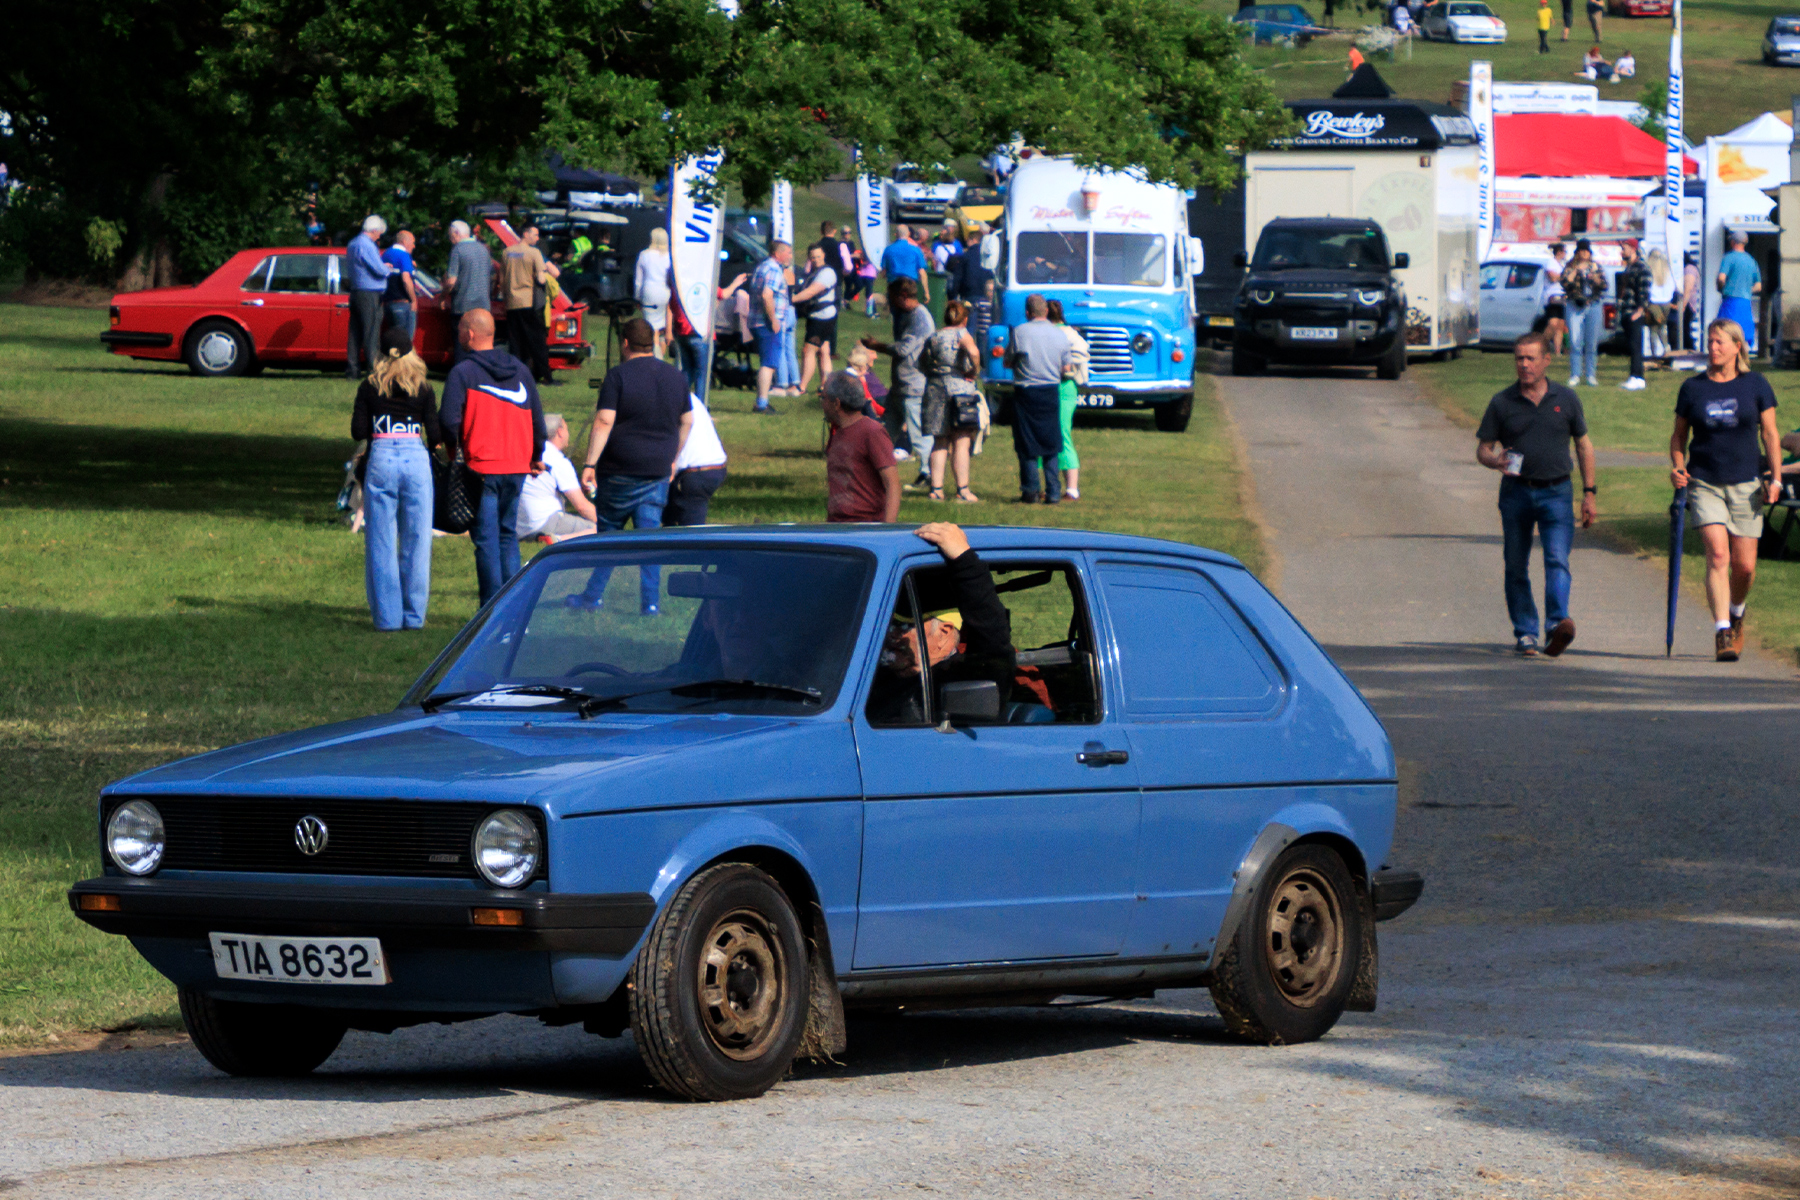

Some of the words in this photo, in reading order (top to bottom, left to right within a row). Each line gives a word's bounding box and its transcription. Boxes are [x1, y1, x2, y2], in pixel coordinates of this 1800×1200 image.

[1302, 110, 1385, 137] Bewley's
[1668, 69, 1682, 154] VILLAGE
[1667, 165, 1681, 223] FOOD
[1744, 214, 1772, 223] STEA
[1089, 394, 1114, 406] 679
[373, 415, 422, 434] Klein
[221, 939, 274, 976] TIA
[279, 943, 373, 979] 8632
